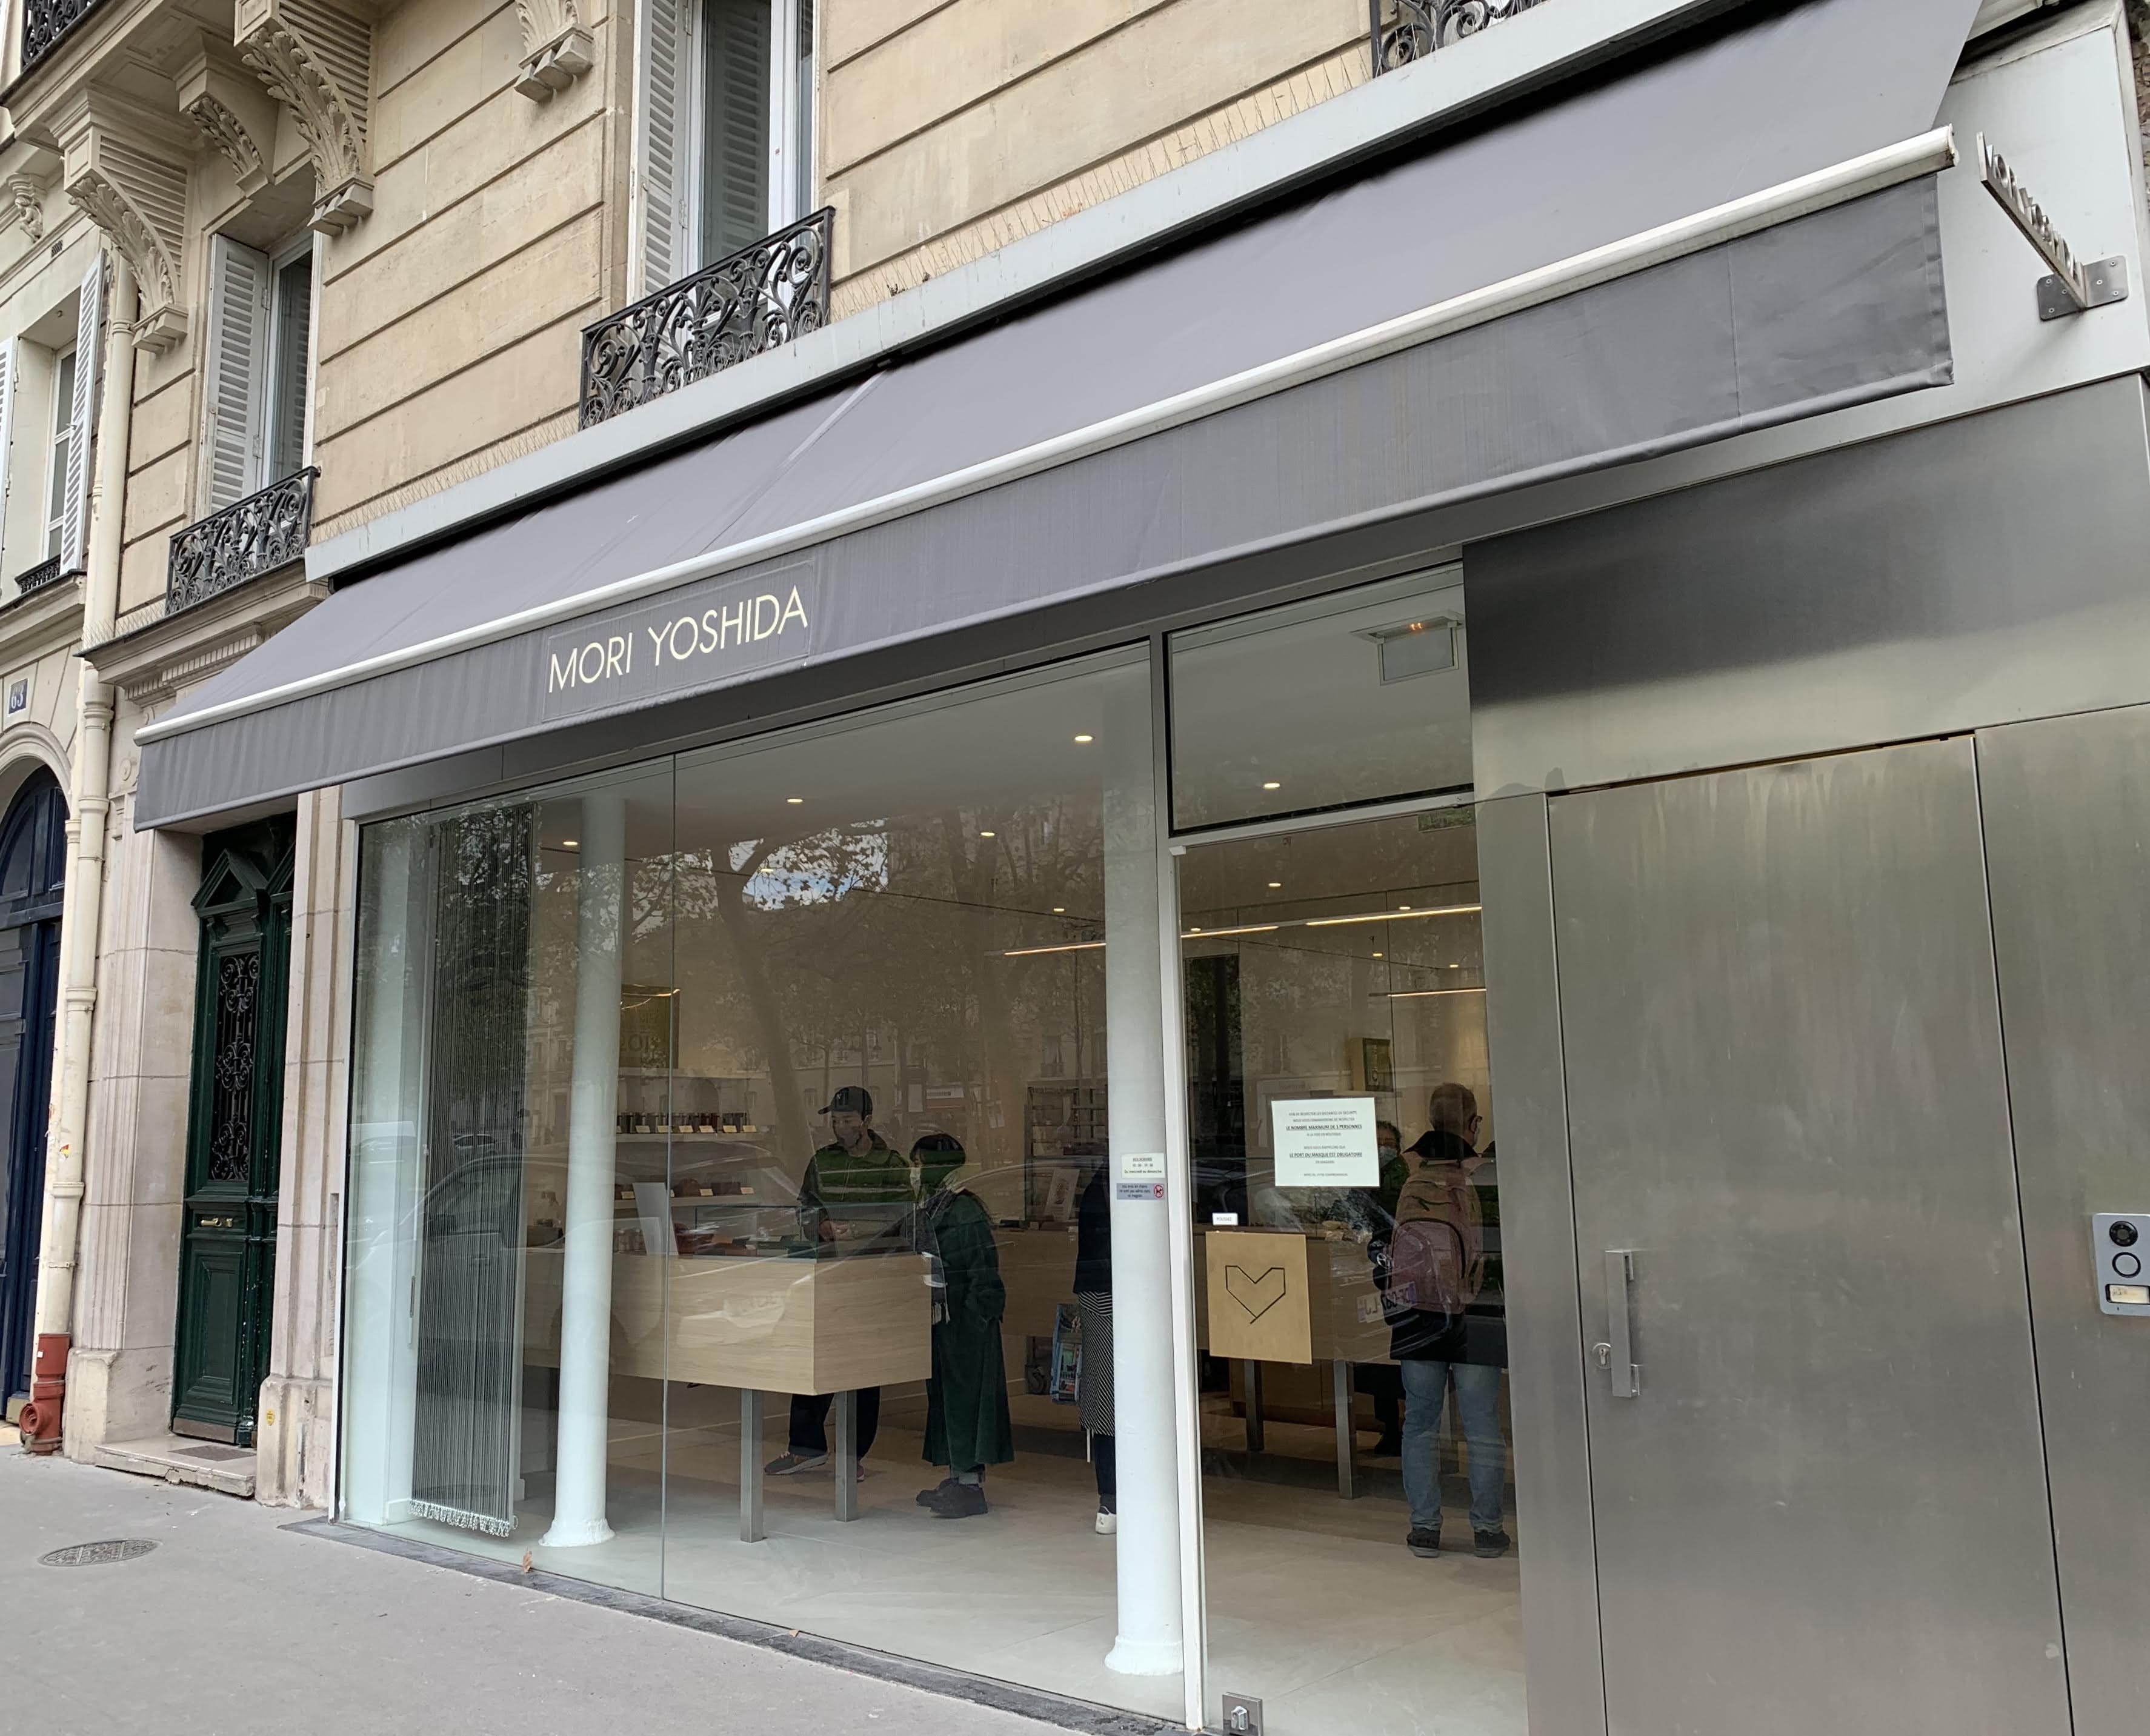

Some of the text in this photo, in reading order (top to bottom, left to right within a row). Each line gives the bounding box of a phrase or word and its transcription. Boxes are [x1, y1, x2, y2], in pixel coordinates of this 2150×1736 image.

[548, 584, 808, 693] MORI YOSHIDA
[11, 684, 24, 710] 63
